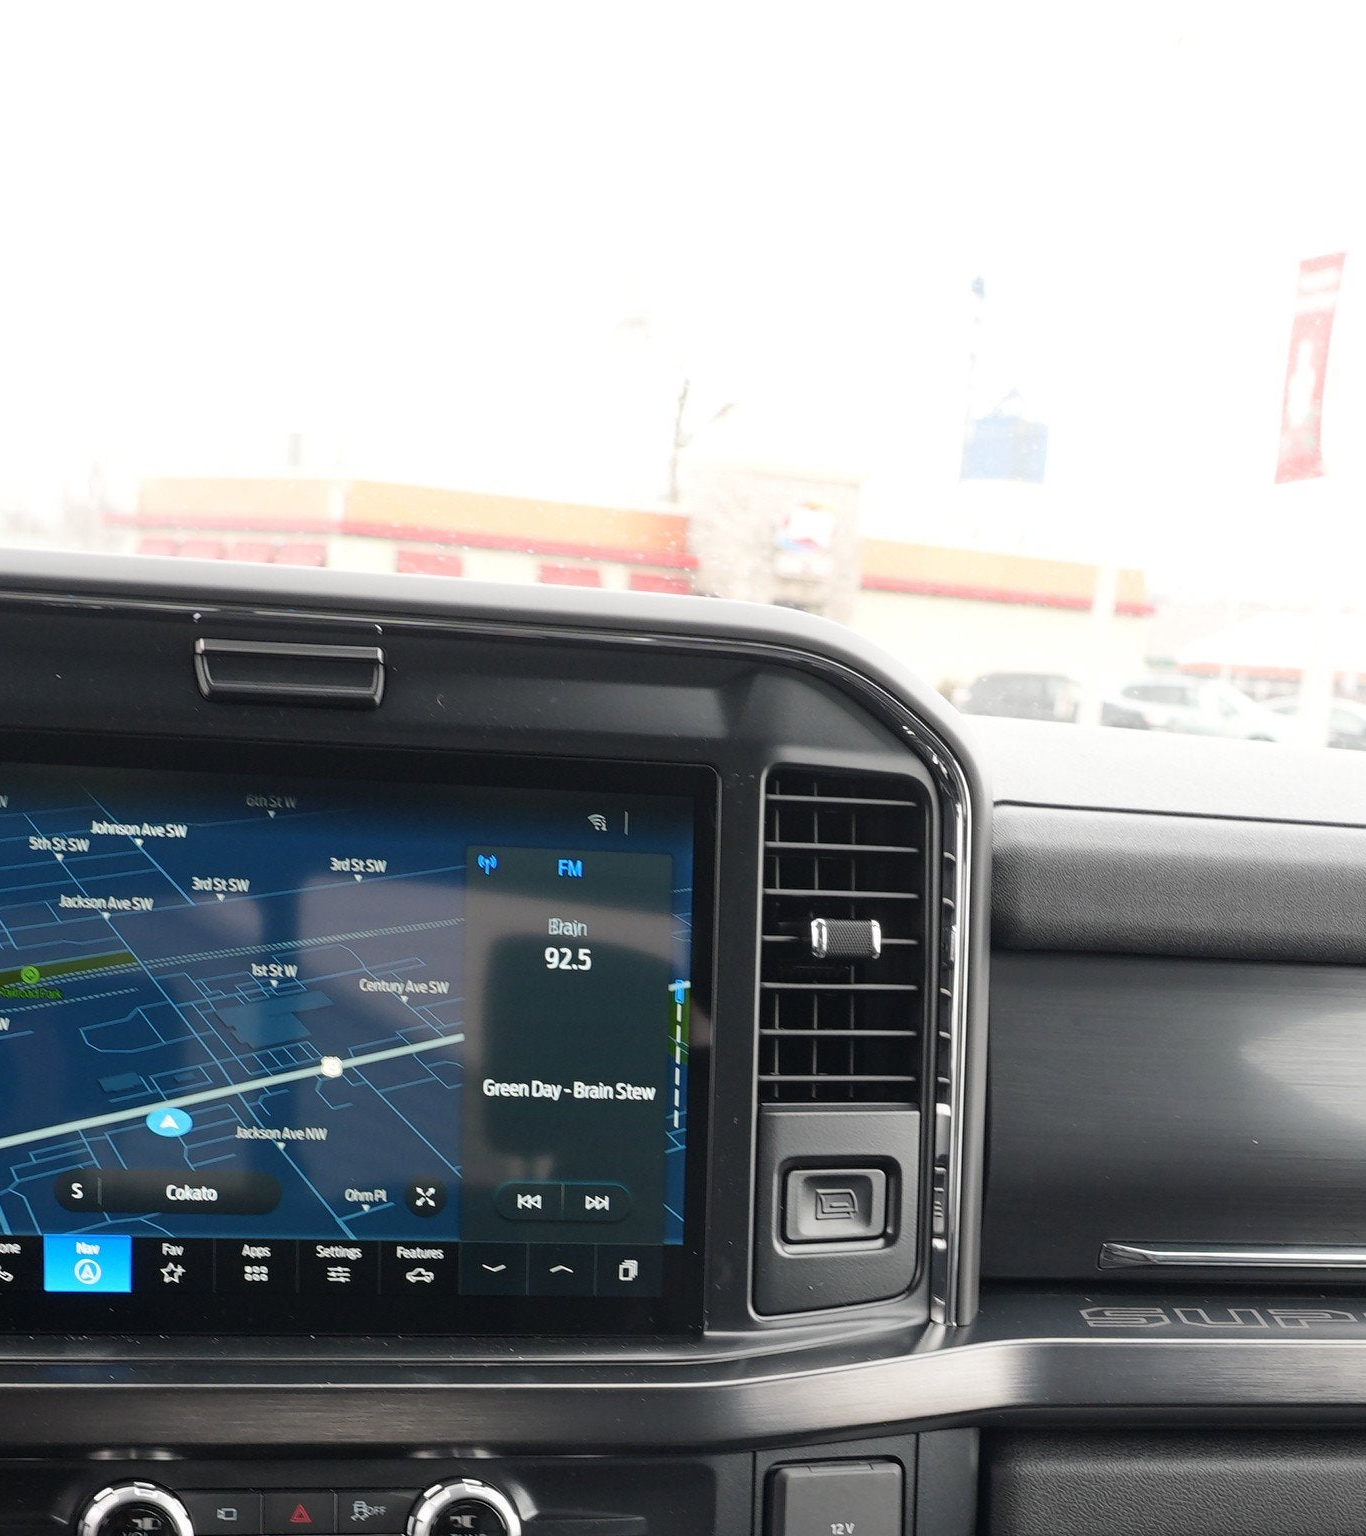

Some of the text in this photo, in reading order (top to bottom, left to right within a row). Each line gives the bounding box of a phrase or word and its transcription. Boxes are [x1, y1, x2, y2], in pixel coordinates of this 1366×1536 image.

[90, 820, 188, 839] Johnson Ave SW
[29, 836, 90, 853] 5th St SW
[330, 858, 387, 874] 3rd St SW
[557, 859, 583, 878] FM
[192, 877, 250, 893] 3rd St SW
[59, 894, 154, 912] Jackson Ave SW
[544, 946, 592, 971] 92.5
[251, 963, 298, 978] 1st St W
[359, 978, 450, 996] Century Ave SW
[483, 1079, 530, 1098] Green
[531, 1081, 562, 1101] Day
[573, 1081, 614, 1100] Brain
[615, 1084, 656, 1102] Stew
[235, 1125, 327, 1142] Jackson Ave NW
[71, 1183, 83, 1200] S
[165, 1184, 218, 1202] Cokato
[345, 1189, 387, 1203] Ohm Pl
[76, 1242, 101, 1256] Nav
[162, 1243, 184, 1257] Fav
[242, 1245, 271, 1260] Apps
[315, 1245, 362, 1261] Settings
[396, 1246, 444, 1261] Features
[367, 1505, 387, 1517] OFF
